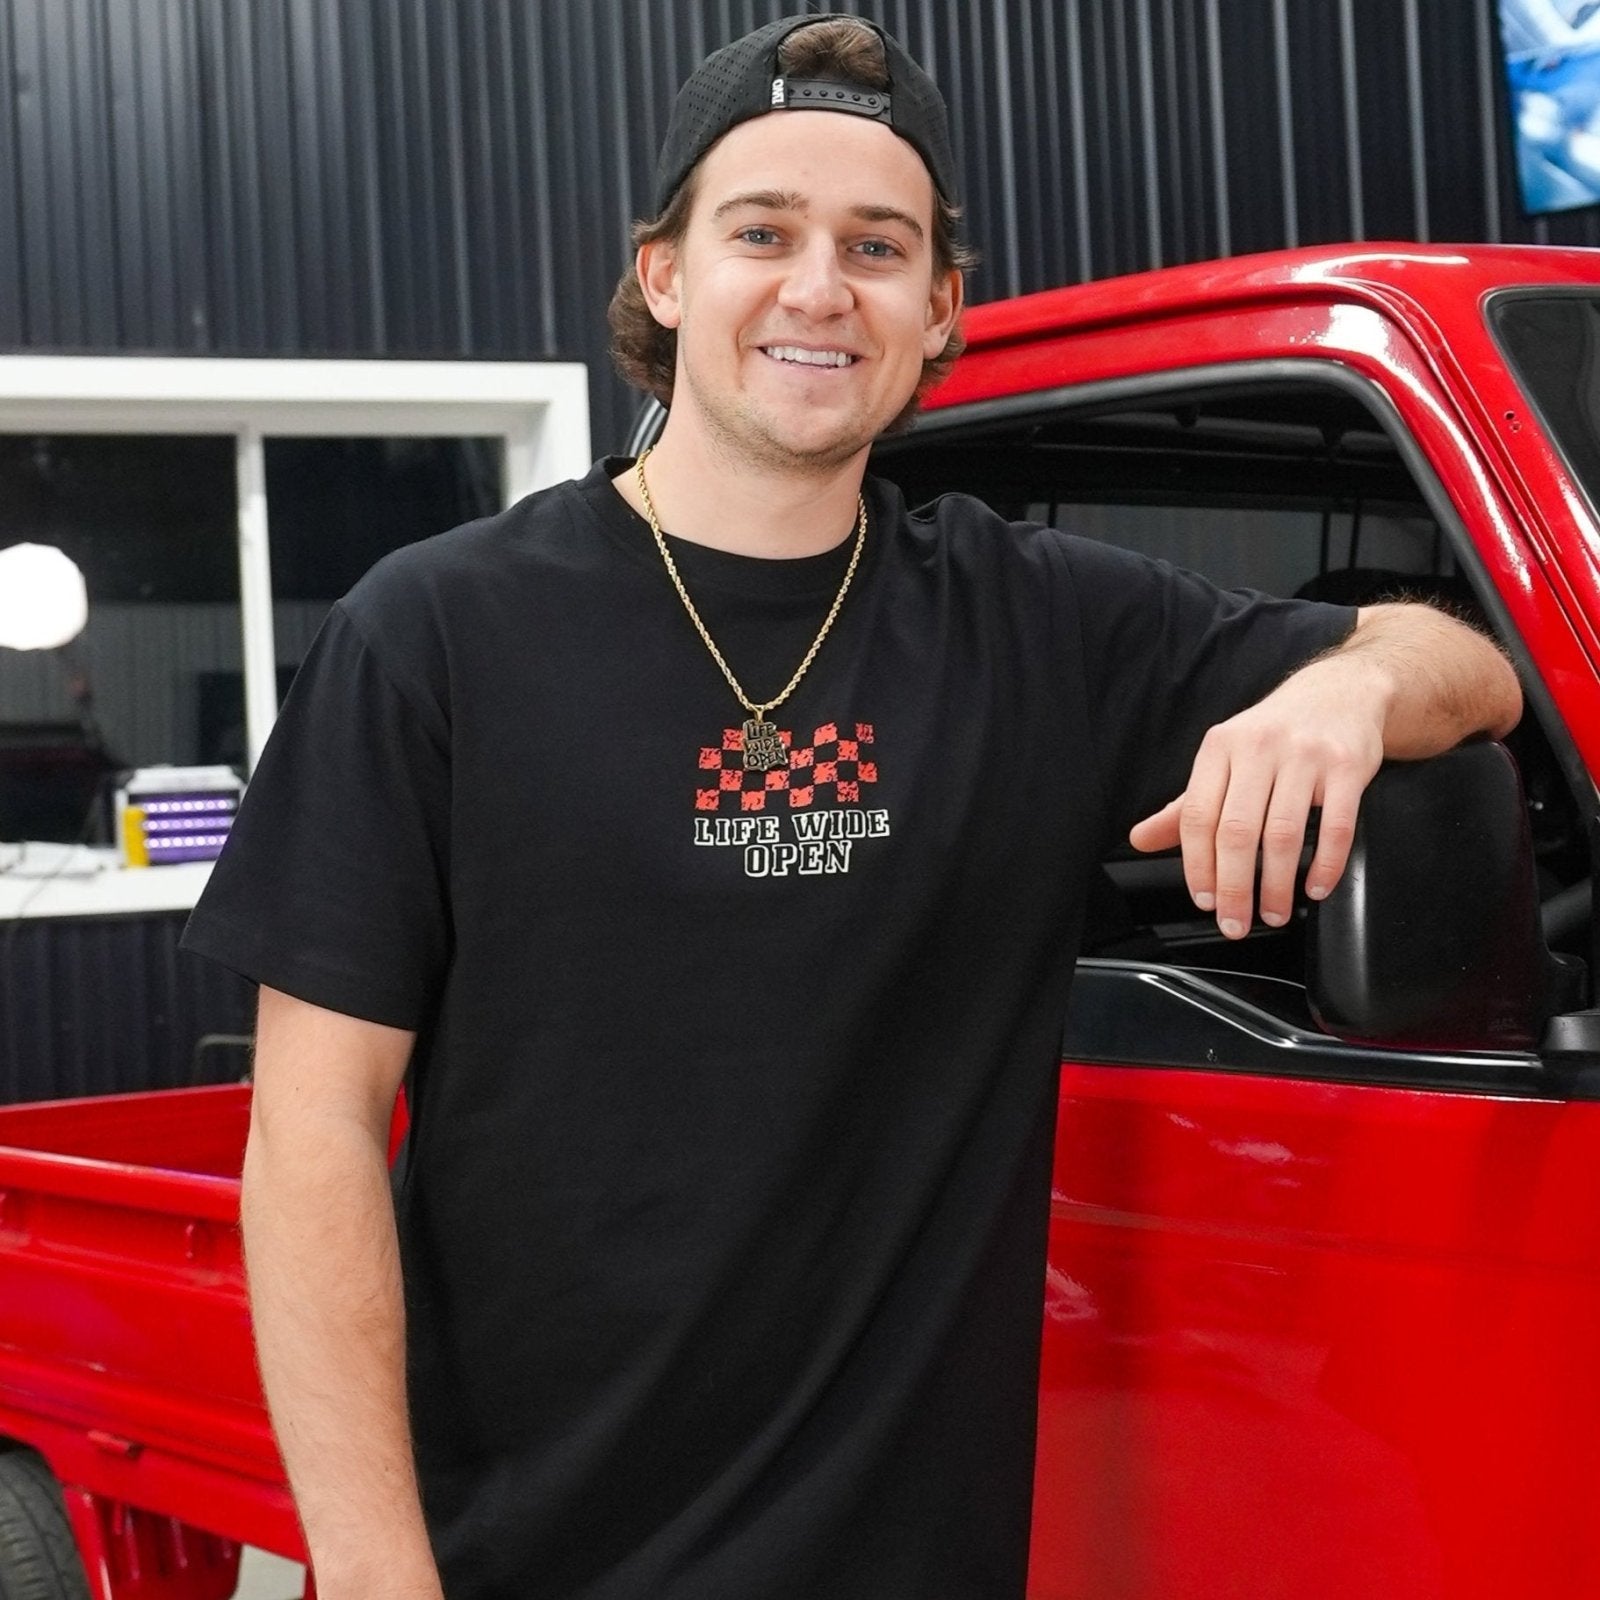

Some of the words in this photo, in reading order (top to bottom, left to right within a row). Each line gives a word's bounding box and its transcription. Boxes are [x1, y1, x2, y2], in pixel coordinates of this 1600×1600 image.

[747, 750, 787, 768] OPEN
[694, 816, 780, 846] LIFE
[791, 809, 890, 841] WIDE
[744, 840, 852, 877] OPEN
